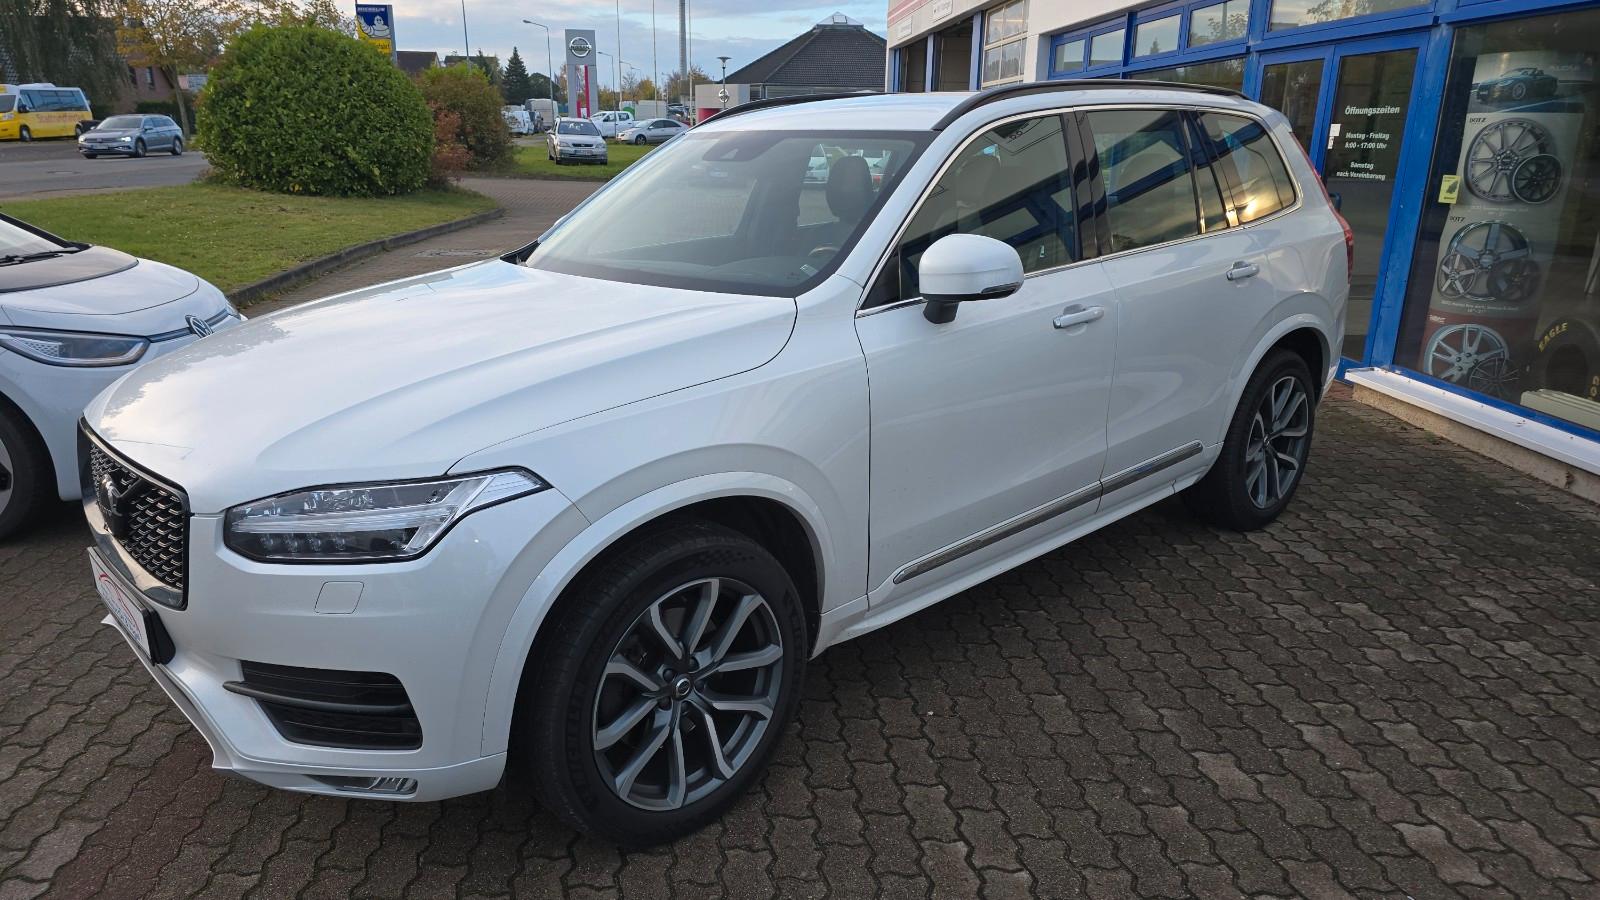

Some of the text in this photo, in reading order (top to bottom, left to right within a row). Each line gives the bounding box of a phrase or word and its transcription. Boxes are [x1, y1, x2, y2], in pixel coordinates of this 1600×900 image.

[1344, 105, 1400, 116] Öffnungszeiten
[1345, 132, 1365, 140] Montag
[1369, 132, 1390, 140] Freitag
[1350, 161, 1375, 170] Samstag
[1350, 171, 1386, 181] Vereinbarung
[1538, 322, 1569, 352] EAGLE
